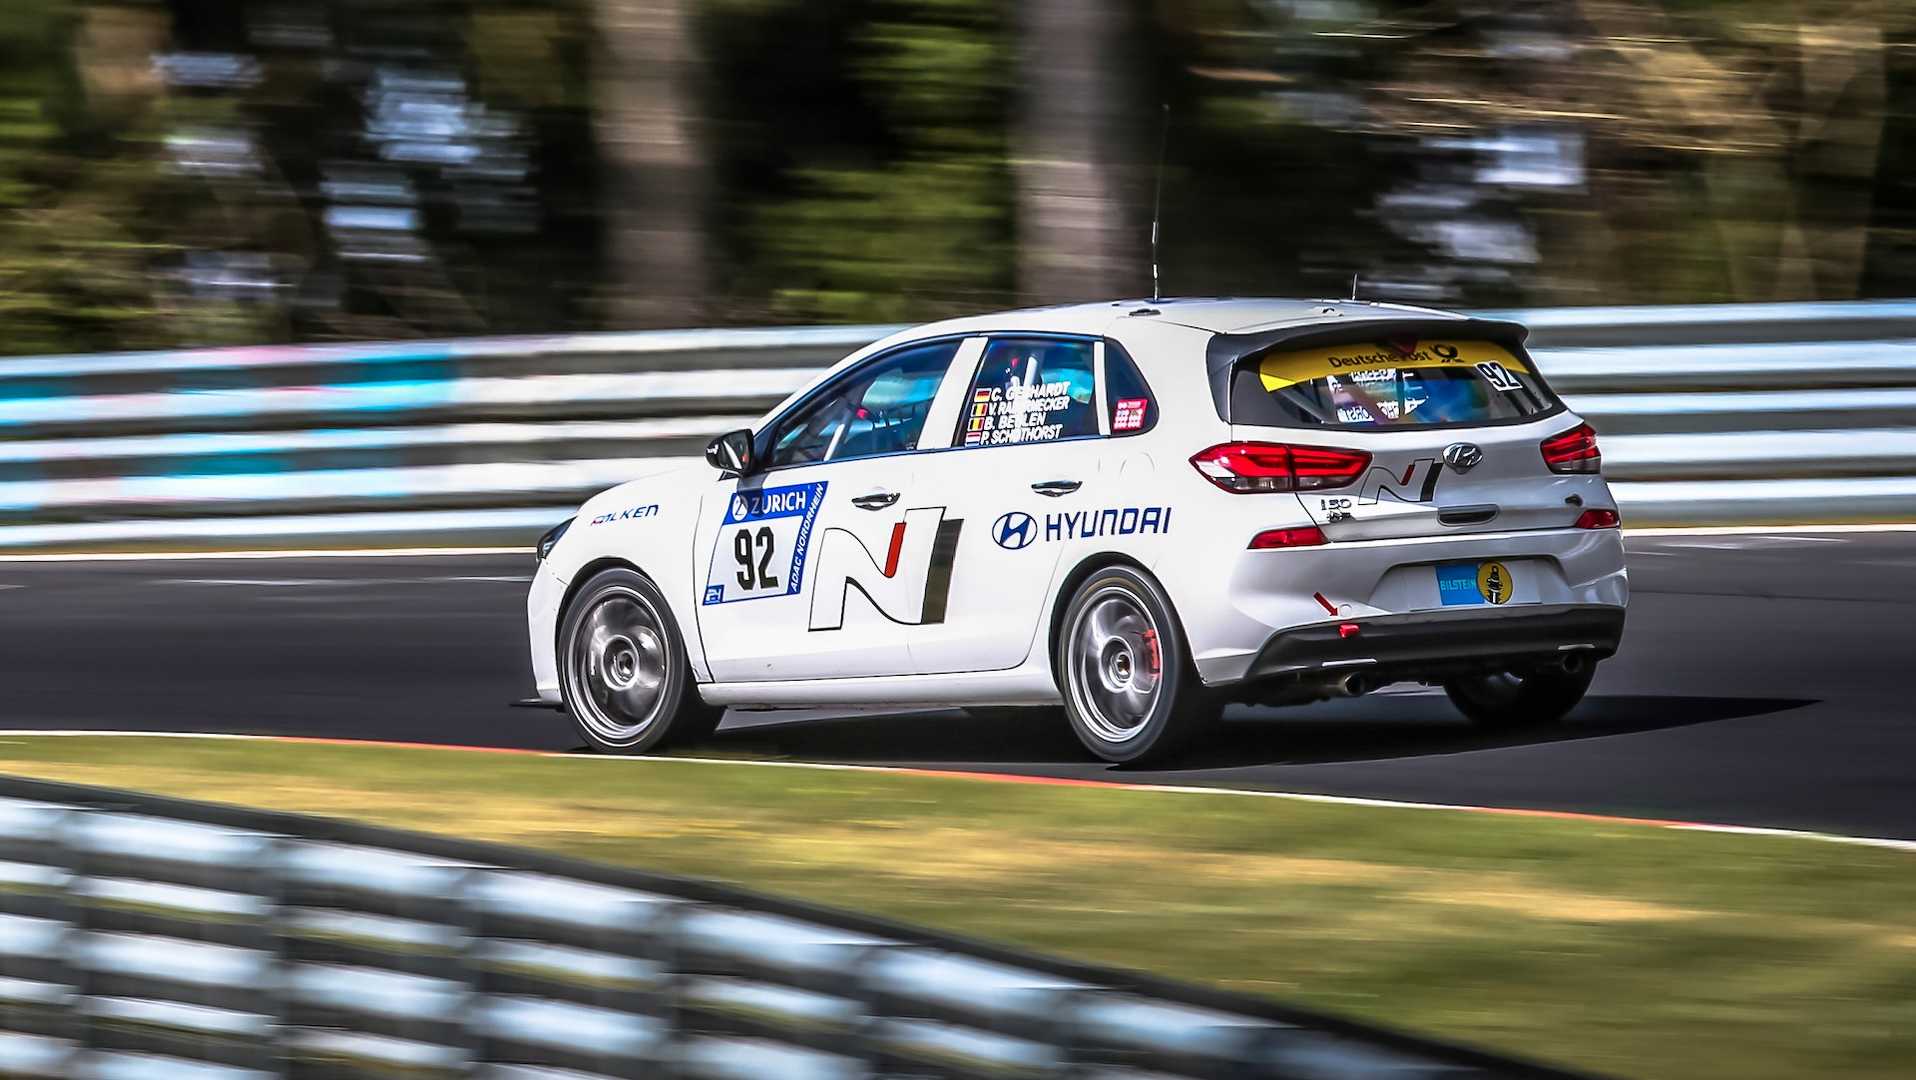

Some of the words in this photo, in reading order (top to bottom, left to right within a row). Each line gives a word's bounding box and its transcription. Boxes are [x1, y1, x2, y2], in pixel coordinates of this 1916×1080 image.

[1328, 351, 1399, 368] Deutsche
[1401, 350, 1432, 363] ost
[1476, 361, 1521, 389] 92
[991, 387, 1003, 402] C.
[1006, 381, 1071, 401] GEHARDT
[998, 412, 1047, 430] BELEN
[751, 490, 806, 515] ZURICH
[1046, 507, 1172, 542] HYUNDAI
[790, 558, 802, 592] ADAC
[796, 483, 824, 556] NORDRHEIN
[735, 526, 779, 591] 92
[1440, 578, 1476, 591] BILSTEIN
